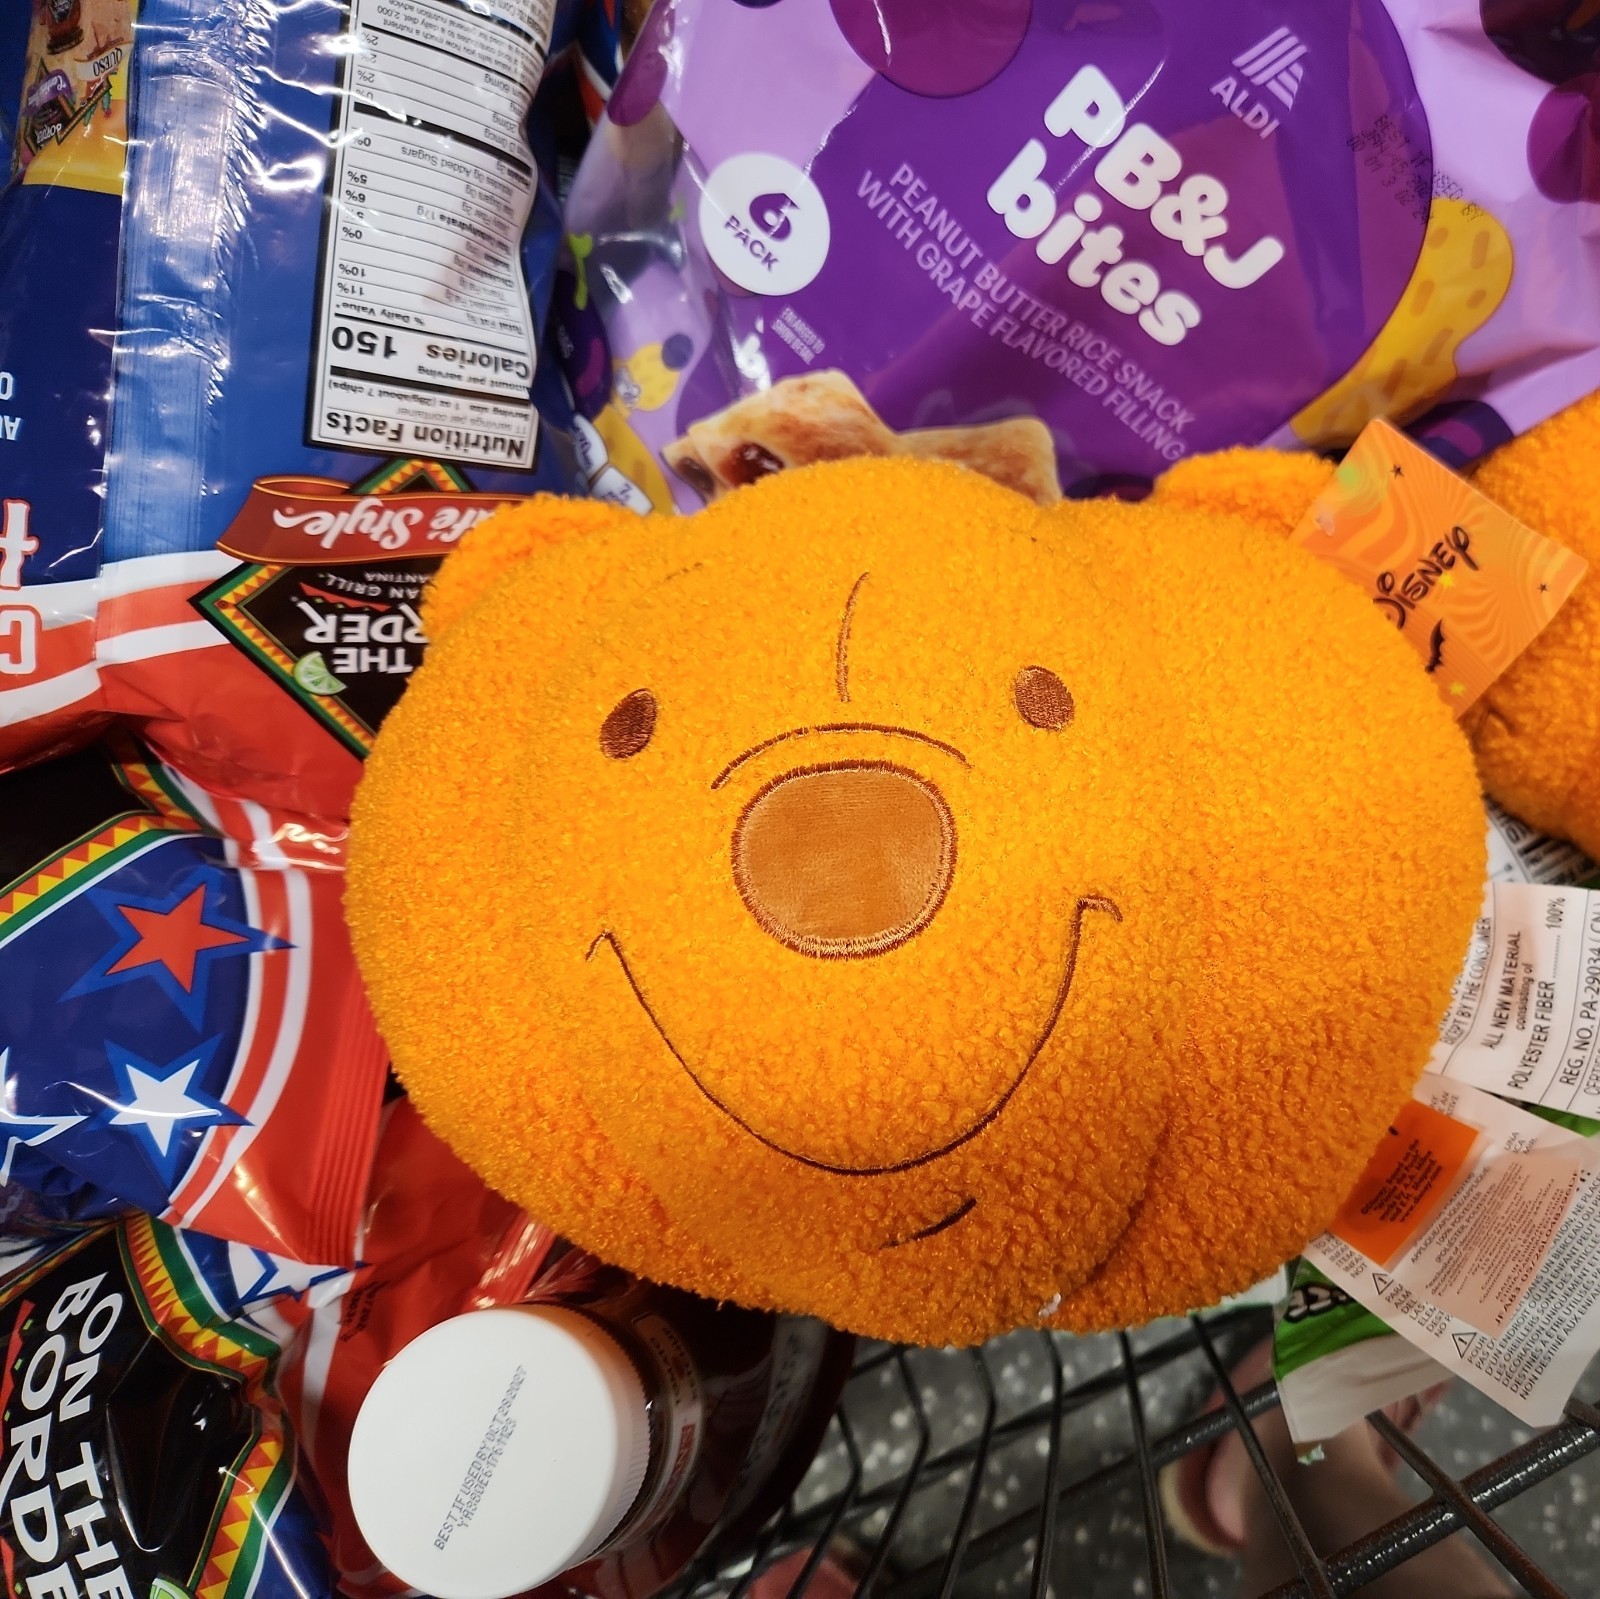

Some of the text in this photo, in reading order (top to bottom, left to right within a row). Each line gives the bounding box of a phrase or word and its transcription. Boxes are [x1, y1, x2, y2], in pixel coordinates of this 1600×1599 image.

[376, 4, 400, 19] 2,000
[382, 17, 414, 34] nutrient
[93, 48, 122, 76] QUESO
[355, 68, 375, 83] 2%
[1208, 75, 1280, 141] ALDI
[399, 145, 439, 166] Sugars
[439, 157, 471, 178] Added
[1373, 114, 1411, 148] BEST
[1431, 169, 1464, 201] USED
[346, 169, 368, 184] 5%
[1044, 63, 1285, 290] PB&J
[344, 188, 366, 203] 6%
[748, 190, 796, 243] 6
[341, 226, 362, 239] 0%
[723, 213, 781, 274] PACK
[985, 137, 1202, 347] bites
[337, 262, 366, 277] 10%
[336, 281, 364, 295] 11%
[888, 162, 1196, 436] PEANUT BUTTER RICE SNACK
[379, 308, 410, 323] Daily
[851, 169, 1187, 467] WITH GRAPE FLAVORED FILLING
[329, 325, 530, 380] Calories 150
[809, 338, 826, 354] TO
[327, 379, 364, 394] chips)
[416, 365, 463, 381] serving
[395, 406, 446, 421] container
[469, 416, 512, 432] servings
[492, 406, 529, 421] Serving
[324, 411, 524, 459] Nutrition Facts
[326, 572, 381, 596] GRILL
[364, 572, 431, 582] ANTINA
[296, 600, 427, 642] RDER
[331, 647, 412, 674] THE
[1468, 914, 1491, 980] CONSUMER
[1460, 979, 1480, 1002] THE
[1479, 928, 1522, 1049] ALL NEW MATERIAL
[1506, 894, 1567, 1090] POLYESTER FIBER 100%
[1513, 961, 1534, 1031] consisting of
[1455, 1002, 1472, 1018] BY
[1571, 1020, 1595, 1052] NO.
[1558, 1051, 1586, 1086] REG.
[1434, 1225, 1453, 1247] 100%
[1450, 1189, 1483, 1228] POLYESTER
[1497, 1307, 1532, 1349] ENDROIT
[1538, 1277, 1554, 1294] UN
[1549, 1243, 1580, 1280] ENFANT
[1575, 1221, 1597, 1246] PEUT
[1541, 1264, 1591, 1327] UNIQUEMENT
[1491, 1361, 1508, 1382] LES
[1501, 1313, 1540, 1362] OREILLERS
[1535, 1287, 1560, 1315] SONT
[1554, 1270, 1573, 1291] DES
[59, 1293, 123, 1421] ON
[1465, 1334, 1488, 1364] POUR
[1518, 1373, 1540, 1400] NON
[1561, 1313, 1582, 1336] AUX
[483, 1413, 505, 1442] OCT
[474, 1439, 493, 1462] BY
[458, 1459, 484, 1496] USED
[450, 1493, 467, 1513] IF
[432, 1510, 459, 1551] BEST
